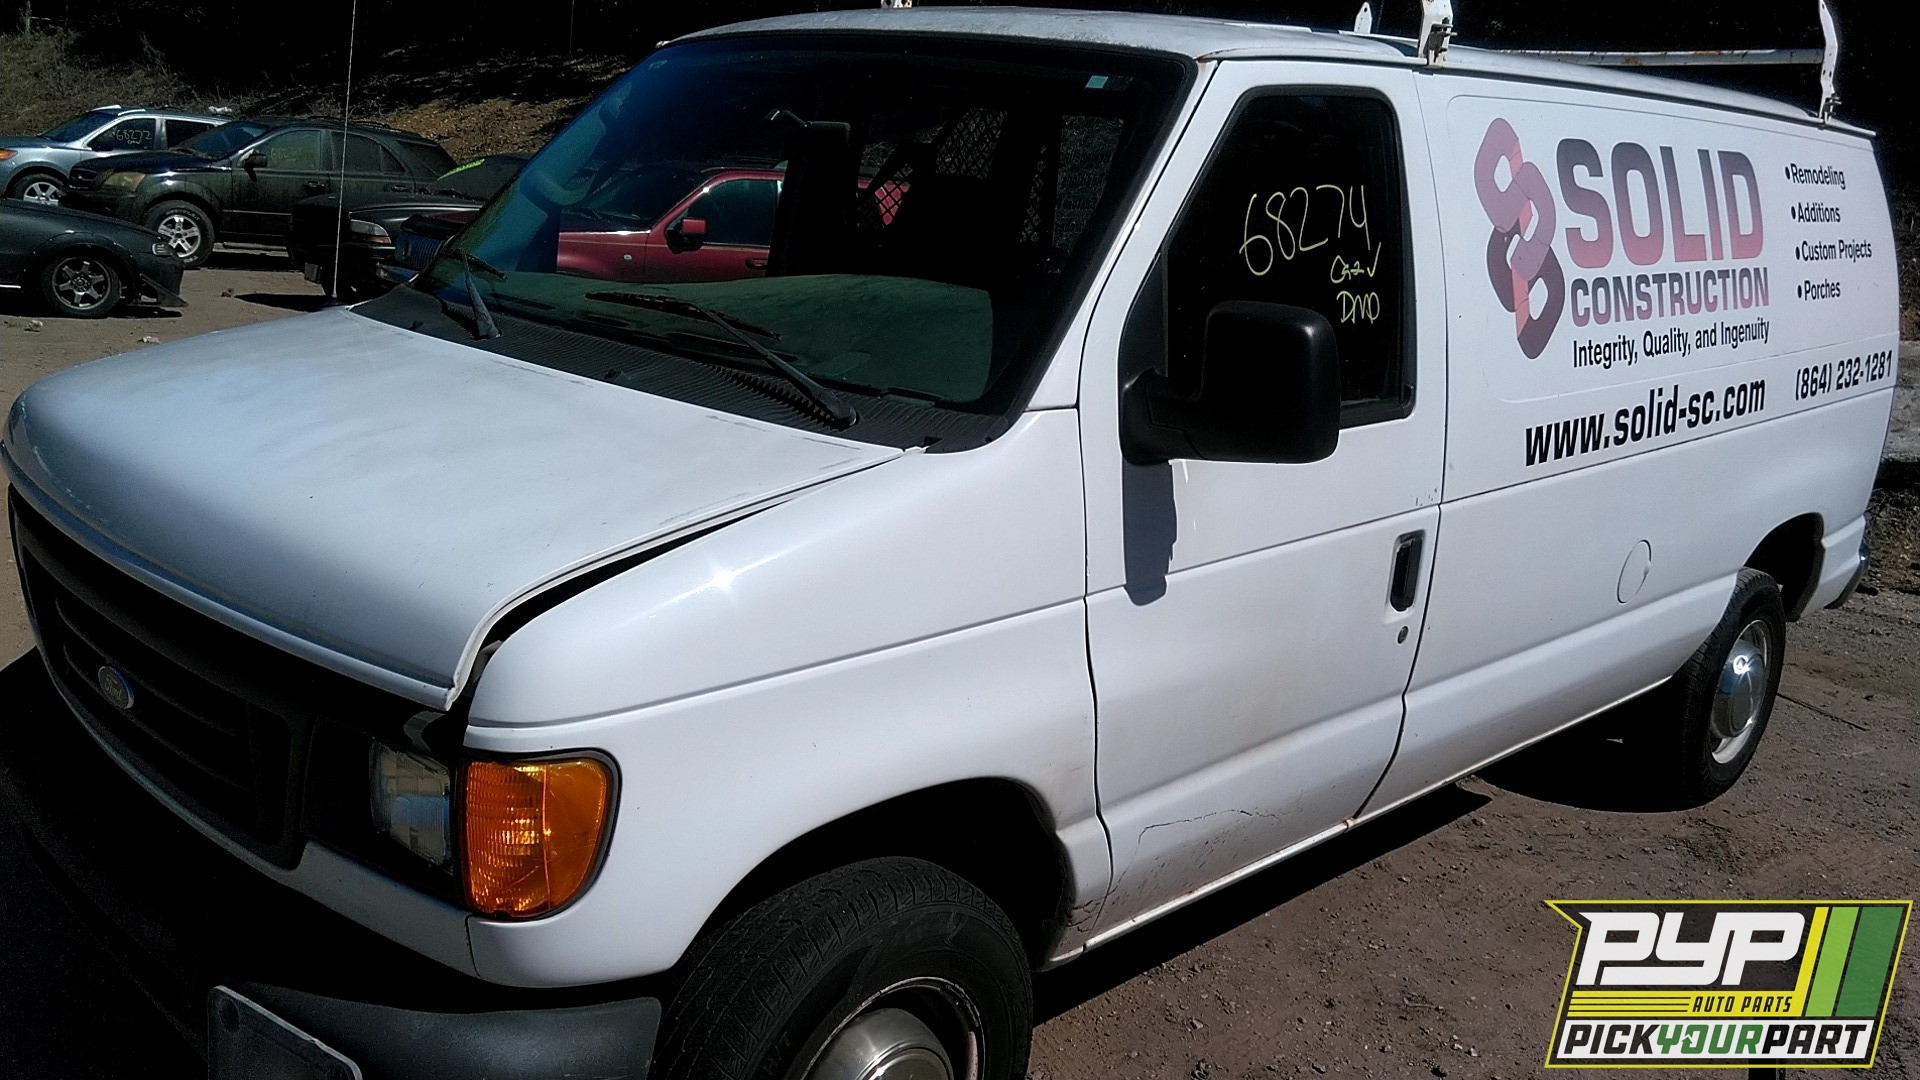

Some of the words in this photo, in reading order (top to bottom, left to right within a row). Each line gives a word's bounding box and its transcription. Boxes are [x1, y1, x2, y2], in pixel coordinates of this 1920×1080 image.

[1790, 163, 1846, 190] Remodeling
[1556, 138, 1764, 268] SOLID
[1797, 202, 1841, 222] Additions
[1239, 184, 1371, 276] 68274
[1801, 240, 1837, 261] Custom
[1838, 239, 1872, 263] Projects
[1570, 267, 1770, 328] CONSTRUCTION
[1804, 278, 1841, 301] Porches
[1573, 335, 1638, 369] Integrity,
[1643, 327, 1691, 357] Quality,
[1695, 322, 1717, 349] and
[1721, 317, 1770, 349] Ingenuity
[1795, 362, 1832, 401] (864)
[1836, 349, 1893, 390] 232-1281
[1525, 378, 1766, 467] www.solid-sc.com
